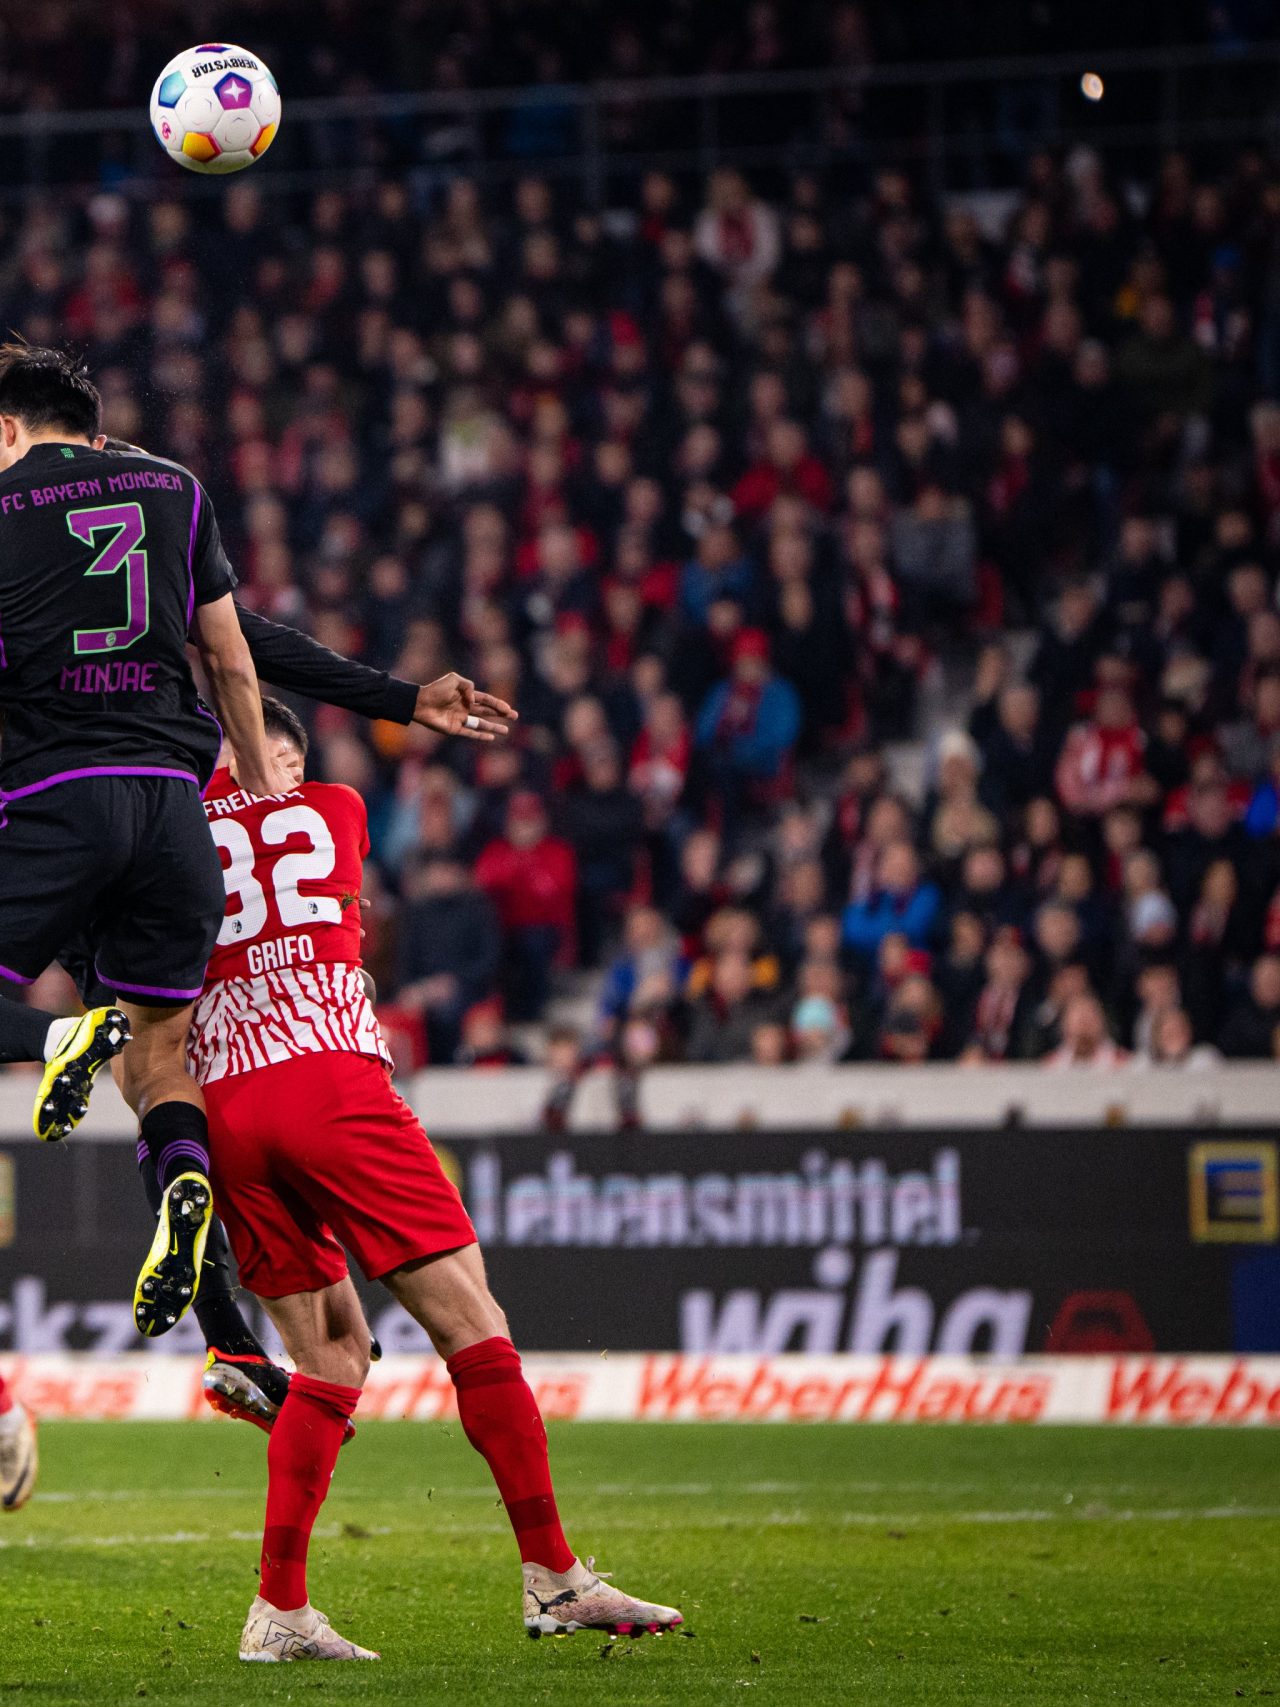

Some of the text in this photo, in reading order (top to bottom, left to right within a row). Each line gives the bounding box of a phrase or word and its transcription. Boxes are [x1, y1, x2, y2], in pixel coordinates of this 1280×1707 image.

[191, 58, 258, 78] DERBYSTAR
[1, 492, 26, 515] FC
[31, 478, 103, 507] BAYERN
[66, 502, 149, 654] 3
[60, 662, 160, 693] MINJAE
[202, 788, 305, 817] FREI
[208, 804, 343, 946] 32
[246, 934, 315, 975] GRIFO
[634, 1354, 1054, 1424] WeberHaus
